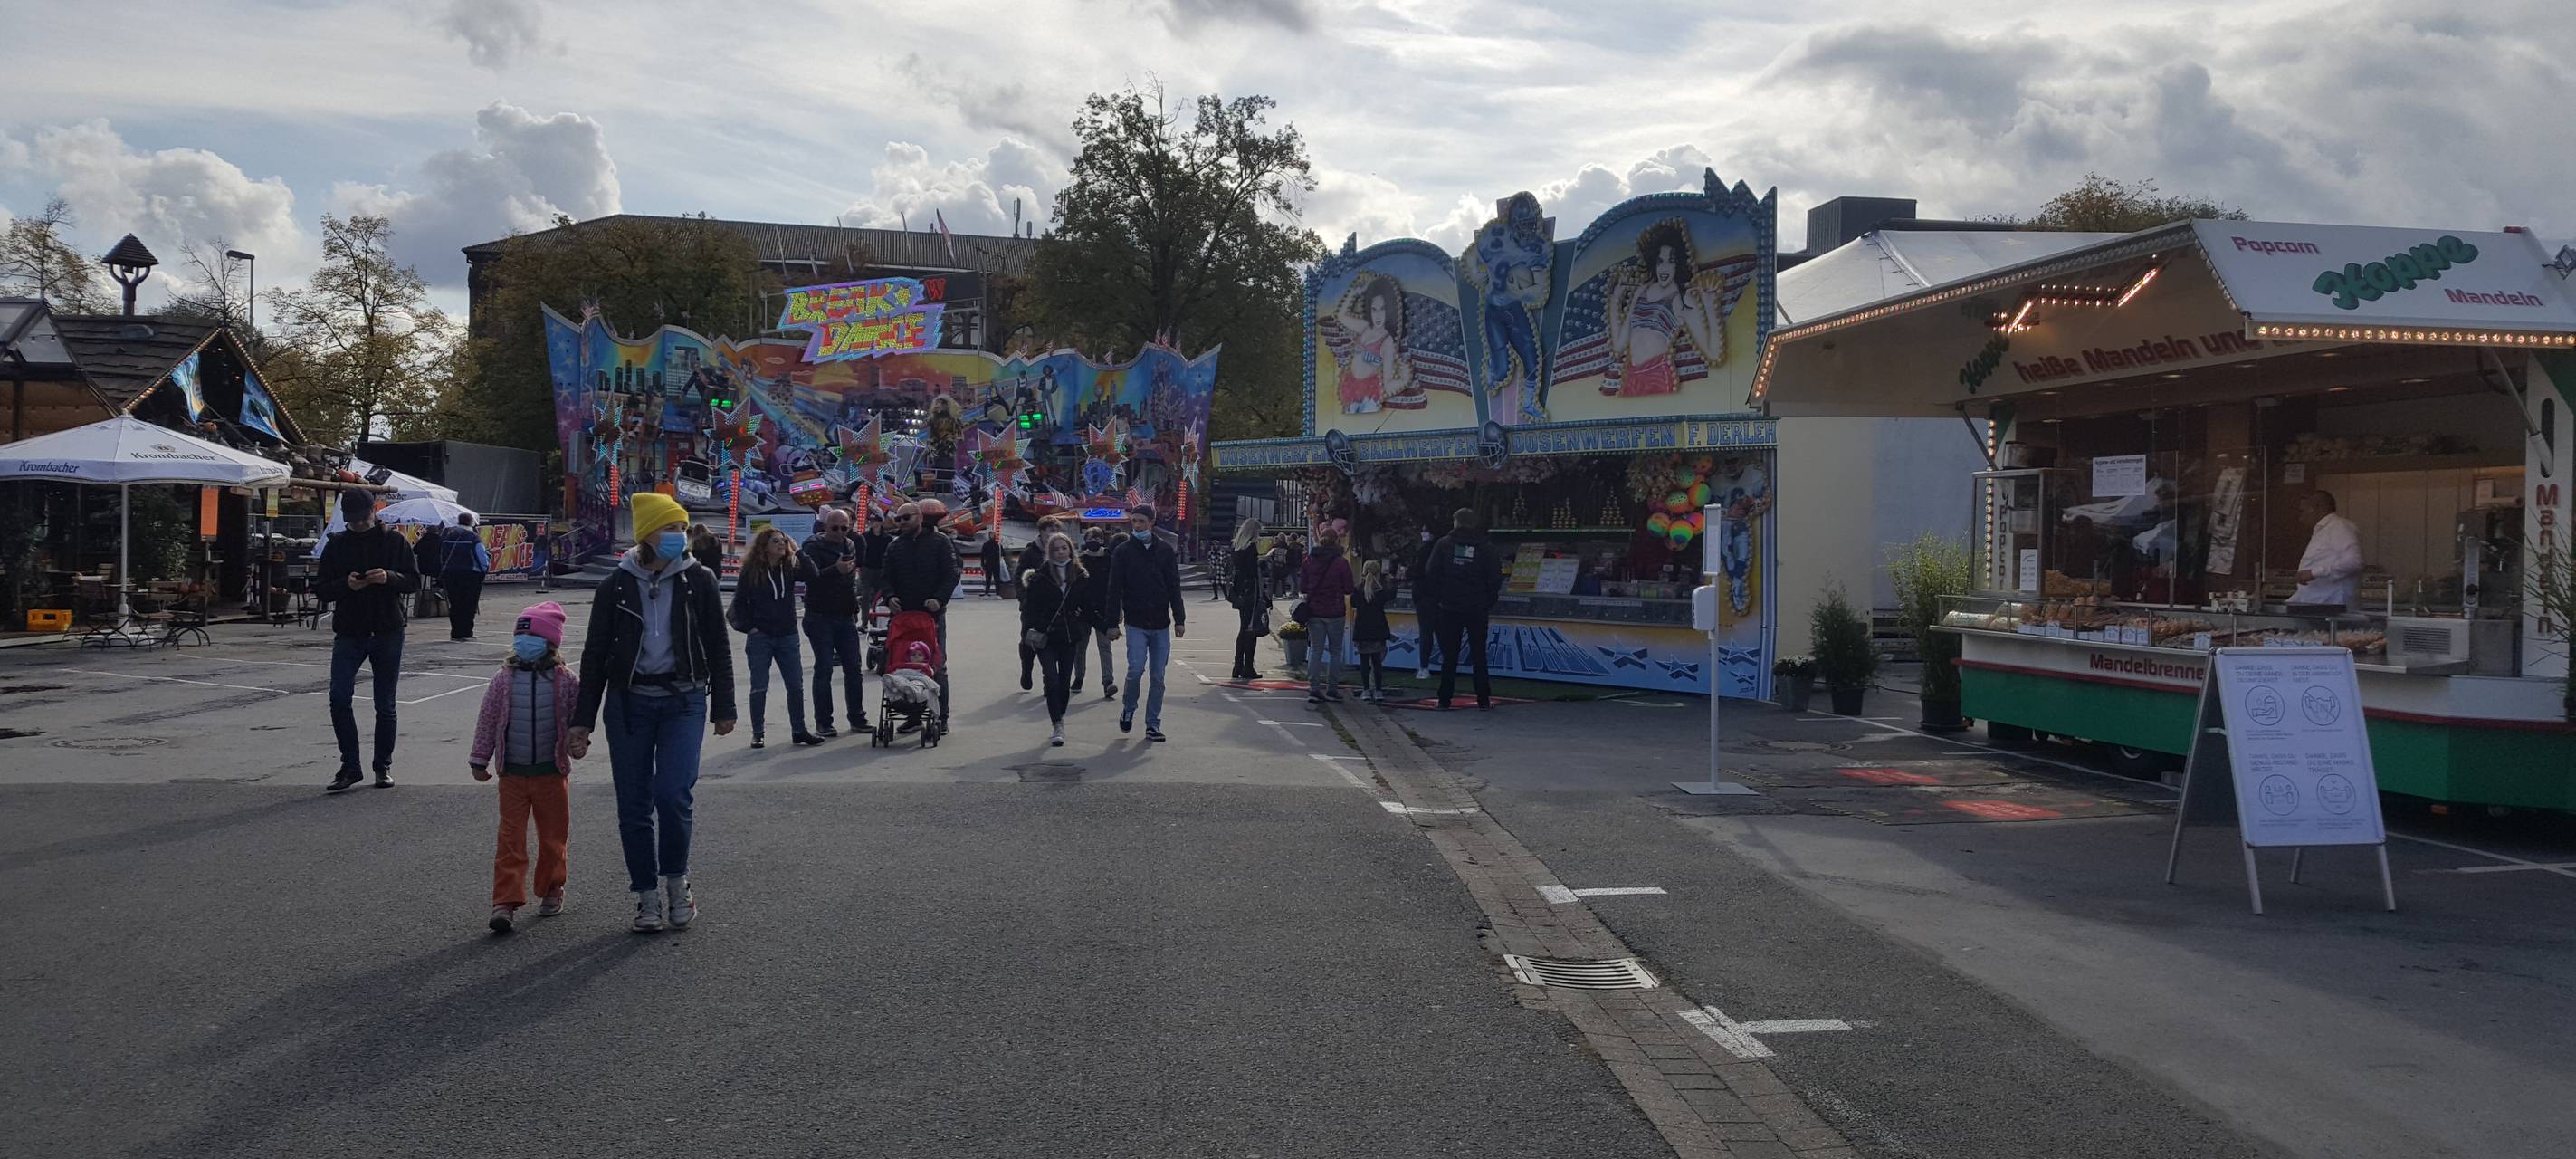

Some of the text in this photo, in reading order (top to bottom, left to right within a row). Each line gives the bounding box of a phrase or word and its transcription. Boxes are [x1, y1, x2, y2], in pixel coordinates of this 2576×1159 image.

[2231, 236, 2321, 255] Popcorn
[2444, 288, 2544, 307] Mandeln
[2013, 355, 2085, 384] heiße
[2083, 335, 2202, 374] Mandeln
[1512, 425, 1675, 455] DOSENWERFEN
[1687, 421, 1777, 446] F. DERLEH
[19, 460, 80, 474] Krombacher
[131, 451, 215, 462] Krombacher
[487, 543, 534, 573] DANCE
